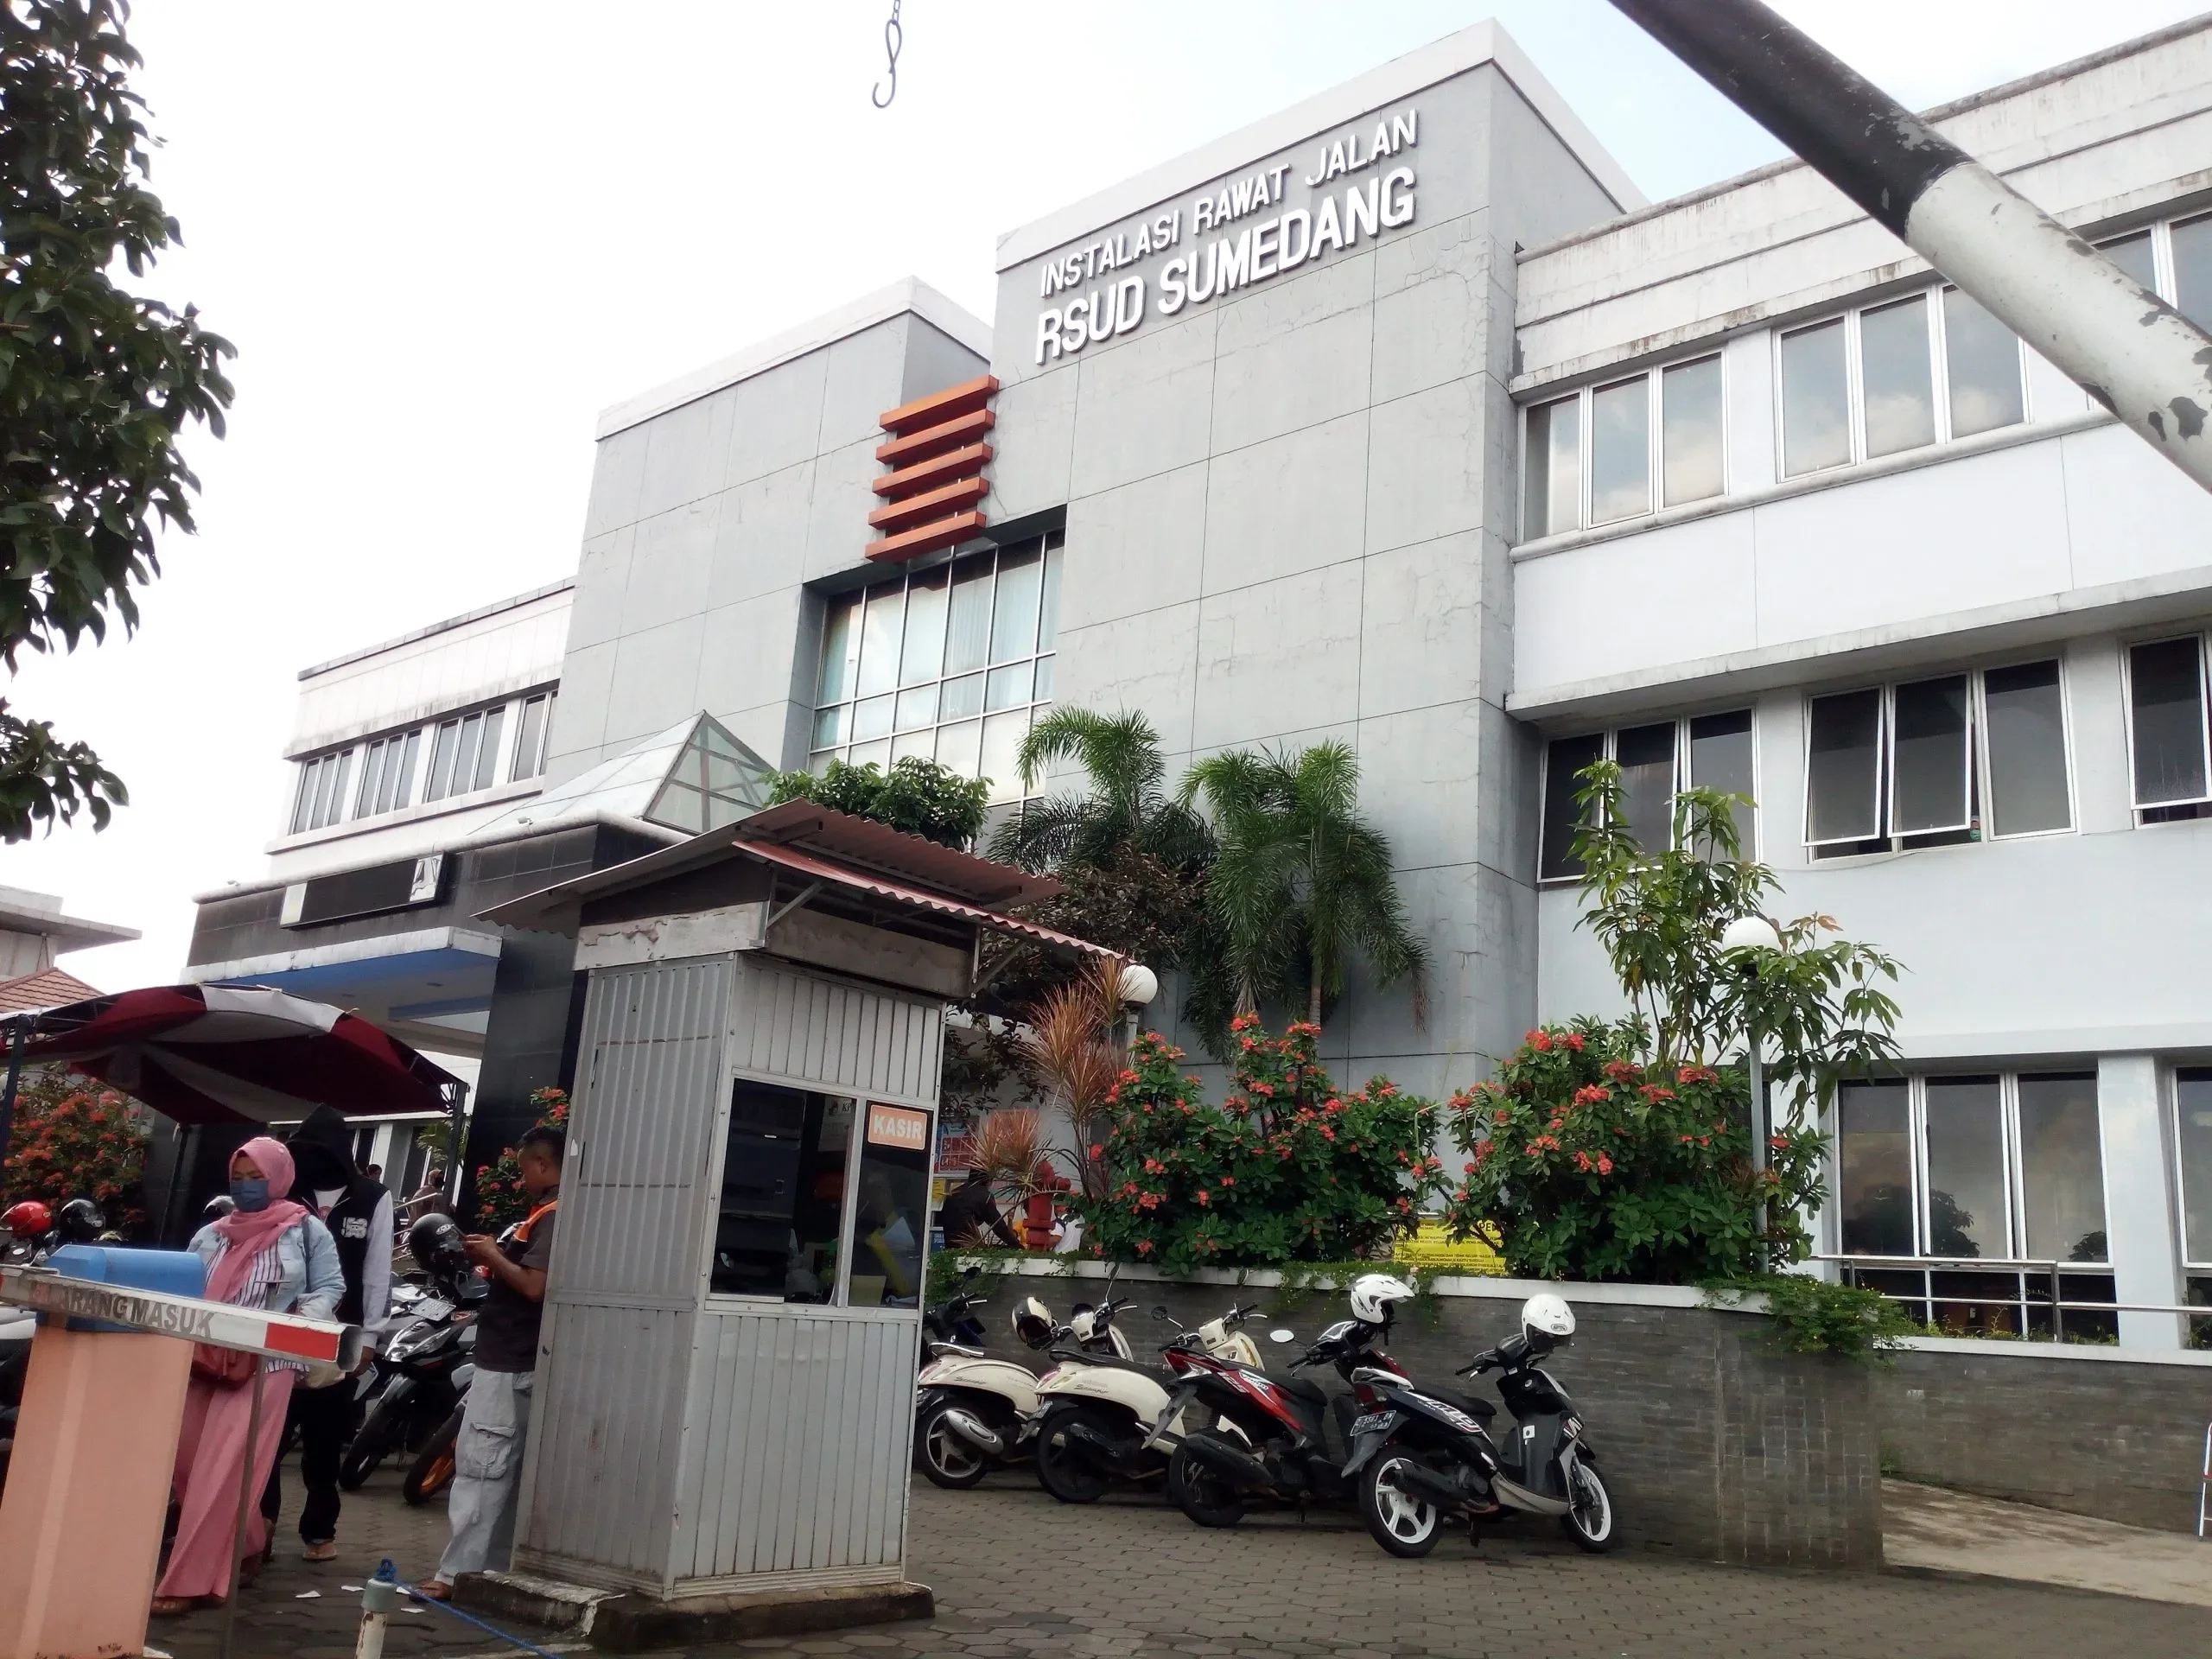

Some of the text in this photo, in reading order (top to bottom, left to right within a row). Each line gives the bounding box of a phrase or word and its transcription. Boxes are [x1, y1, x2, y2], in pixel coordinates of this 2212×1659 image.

[1040, 109, 1419, 298] INSTALASI RAWAT JALAN
[1035, 167, 1417, 366] RSUD SUMEDANG
[873, 1115, 923, 1141] KASIR
[130, 1297, 216, 1338] MASUK
